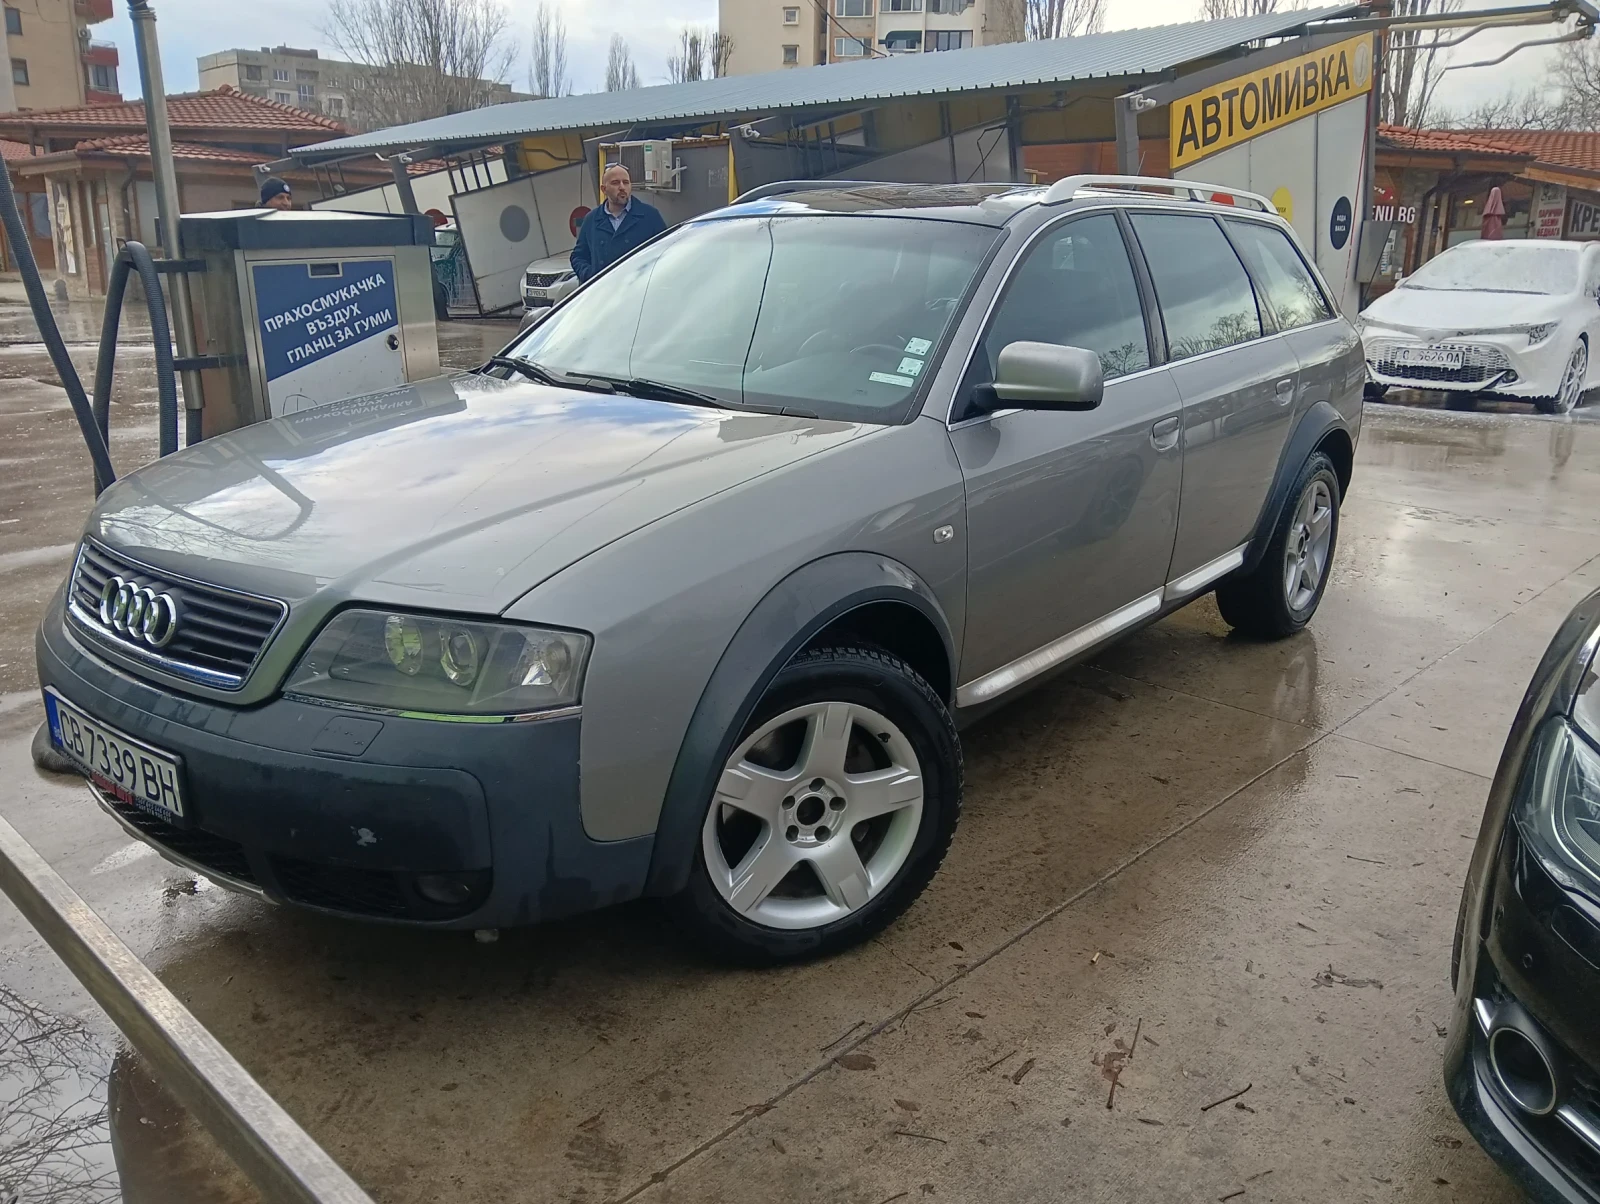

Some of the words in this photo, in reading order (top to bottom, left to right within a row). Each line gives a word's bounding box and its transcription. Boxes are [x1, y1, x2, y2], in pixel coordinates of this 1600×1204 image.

[1177, 50, 1350, 157] АВТОМИВКА
[1398, 206, 1416, 224] BG
[1571, 202, 1600, 236] КРЕ
[264, 273, 386, 333] ПРАХОСМУКАЧКА
[305, 303, 362, 336] ВЪЗДУХ
[286, 334, 337, 364] ГЛАНЦ
[334, 327, 354, 343] ЗА
[354, 309, 392, 335] ГУМИ
